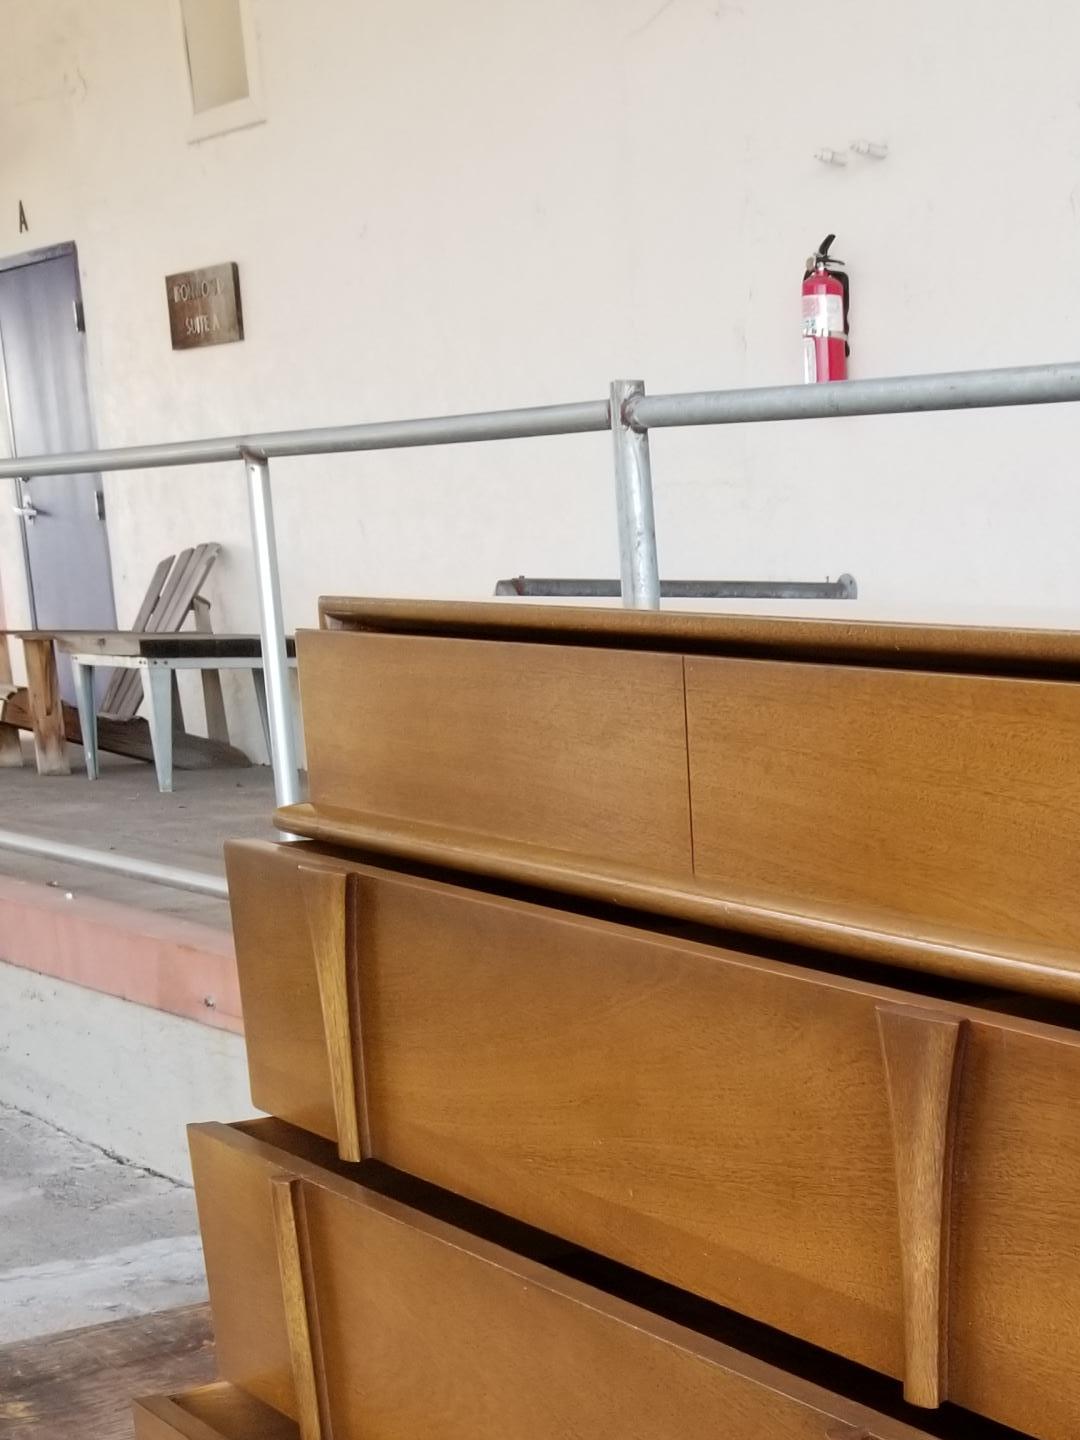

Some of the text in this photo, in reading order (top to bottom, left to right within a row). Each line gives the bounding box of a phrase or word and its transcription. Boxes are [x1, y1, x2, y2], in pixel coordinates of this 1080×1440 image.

[18, 199, 29, 234] A
[185, 313, 220, 336] SUITE A
